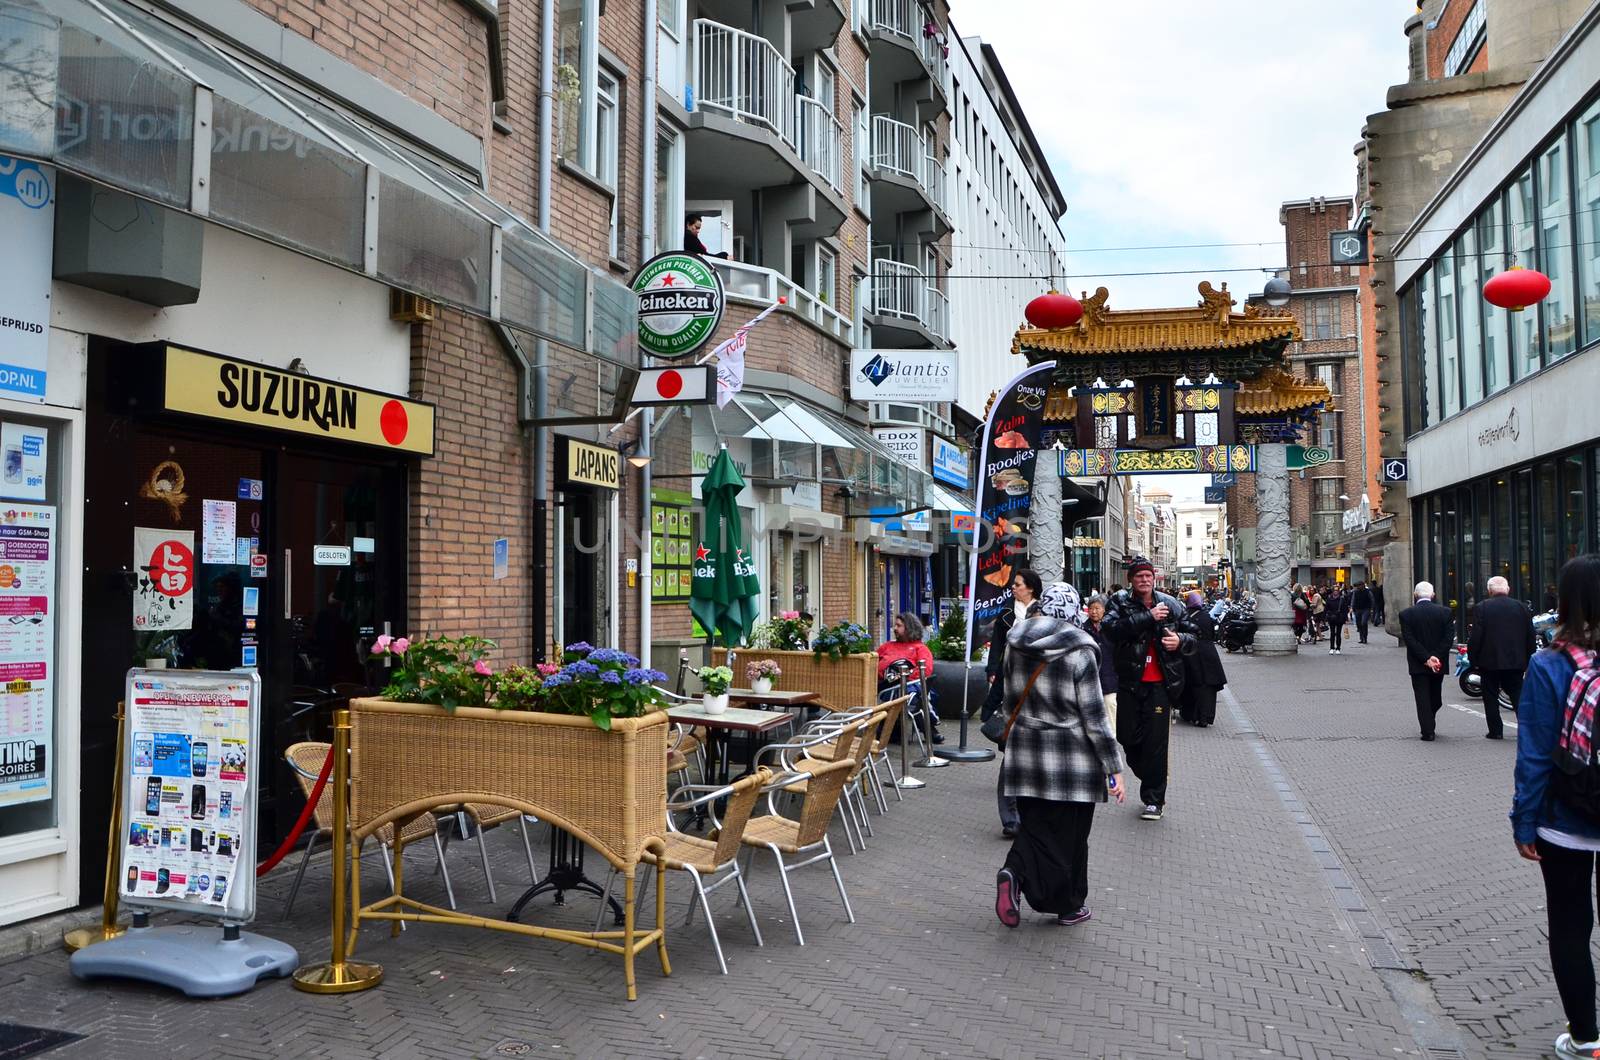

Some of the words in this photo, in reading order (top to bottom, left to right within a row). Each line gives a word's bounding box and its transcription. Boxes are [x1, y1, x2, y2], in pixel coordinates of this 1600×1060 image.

[640, 261, 672, 285] HEINEKEN
[673, 261, 704, 281] PILSENER
[639, 293, 709, 311] eineken
[671, 321, 703, 346] QUALITY
[856, 355, 950, 383] Atlantis
[886, 376, 949, 384] JUWELIER
[217, 363, 357, 432] SUZURAN
[1017, 384, 1035, 394] Onze
[1036, 387, 1046, 397] Vis
[994, 415, 1025, 435] Zalm
[878, 432, 918, 441] EDOX
[886, 441, 919, 451] EIKO
[574, 447, 616, 484] JAPANS
[18, 529, 49, 537] GSM-Shop
[318, 551, 347, 560] GESLOTEN
[181, 692, 211, 703] NIEUWE
[212, 693, 232, 703] SHOP
